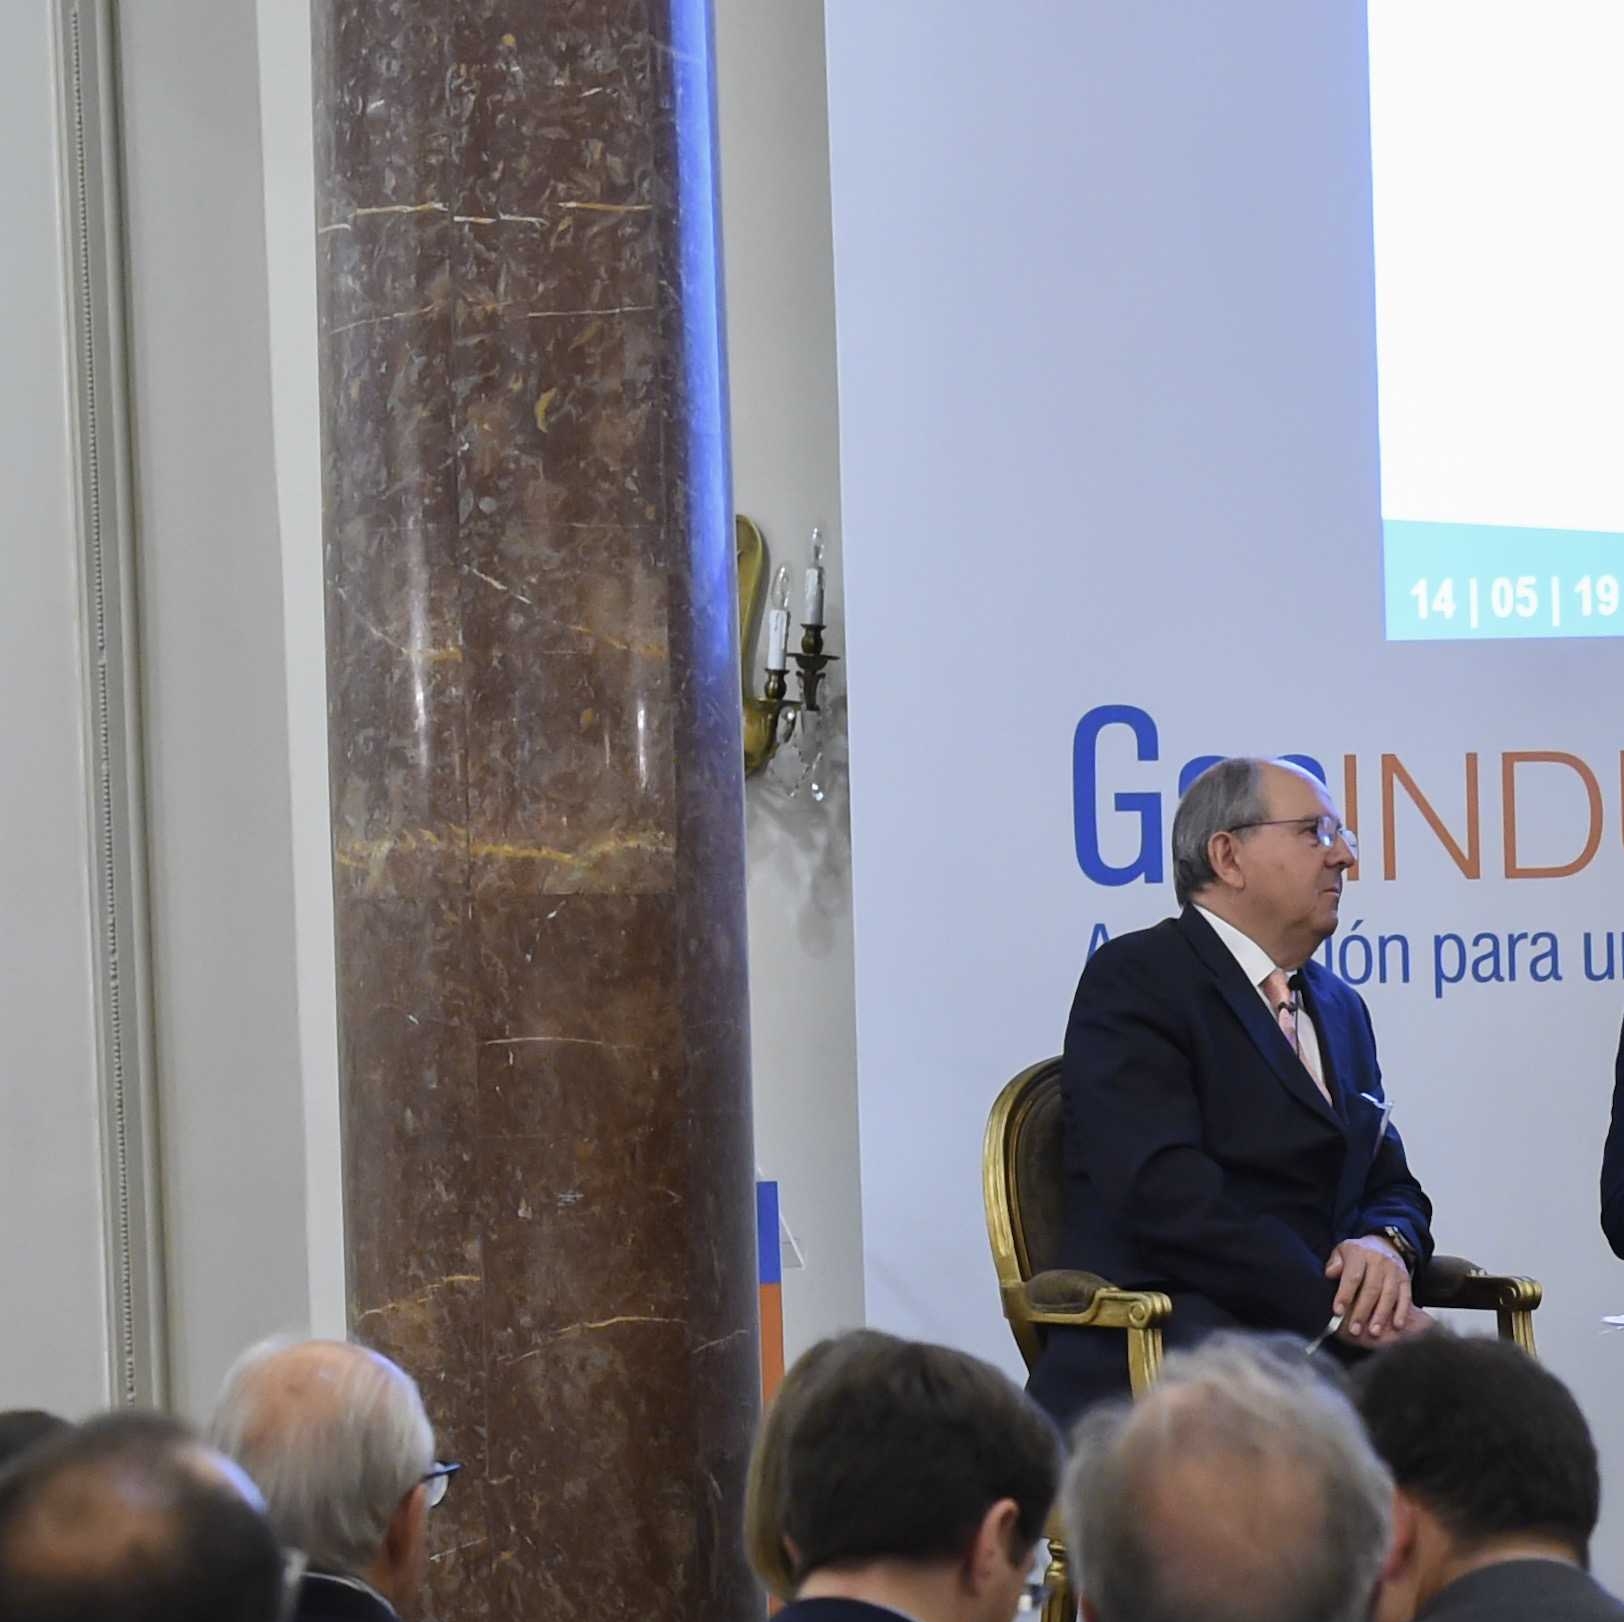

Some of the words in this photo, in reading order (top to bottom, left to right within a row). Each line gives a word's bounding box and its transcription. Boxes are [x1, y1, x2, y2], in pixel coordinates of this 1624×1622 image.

[1409, 577, 1456, 620] 14
[1490, 575, 1538, 619] 05
[1574, 574, 1620, 616] 19
[1433, 930, 1562, 999] para
